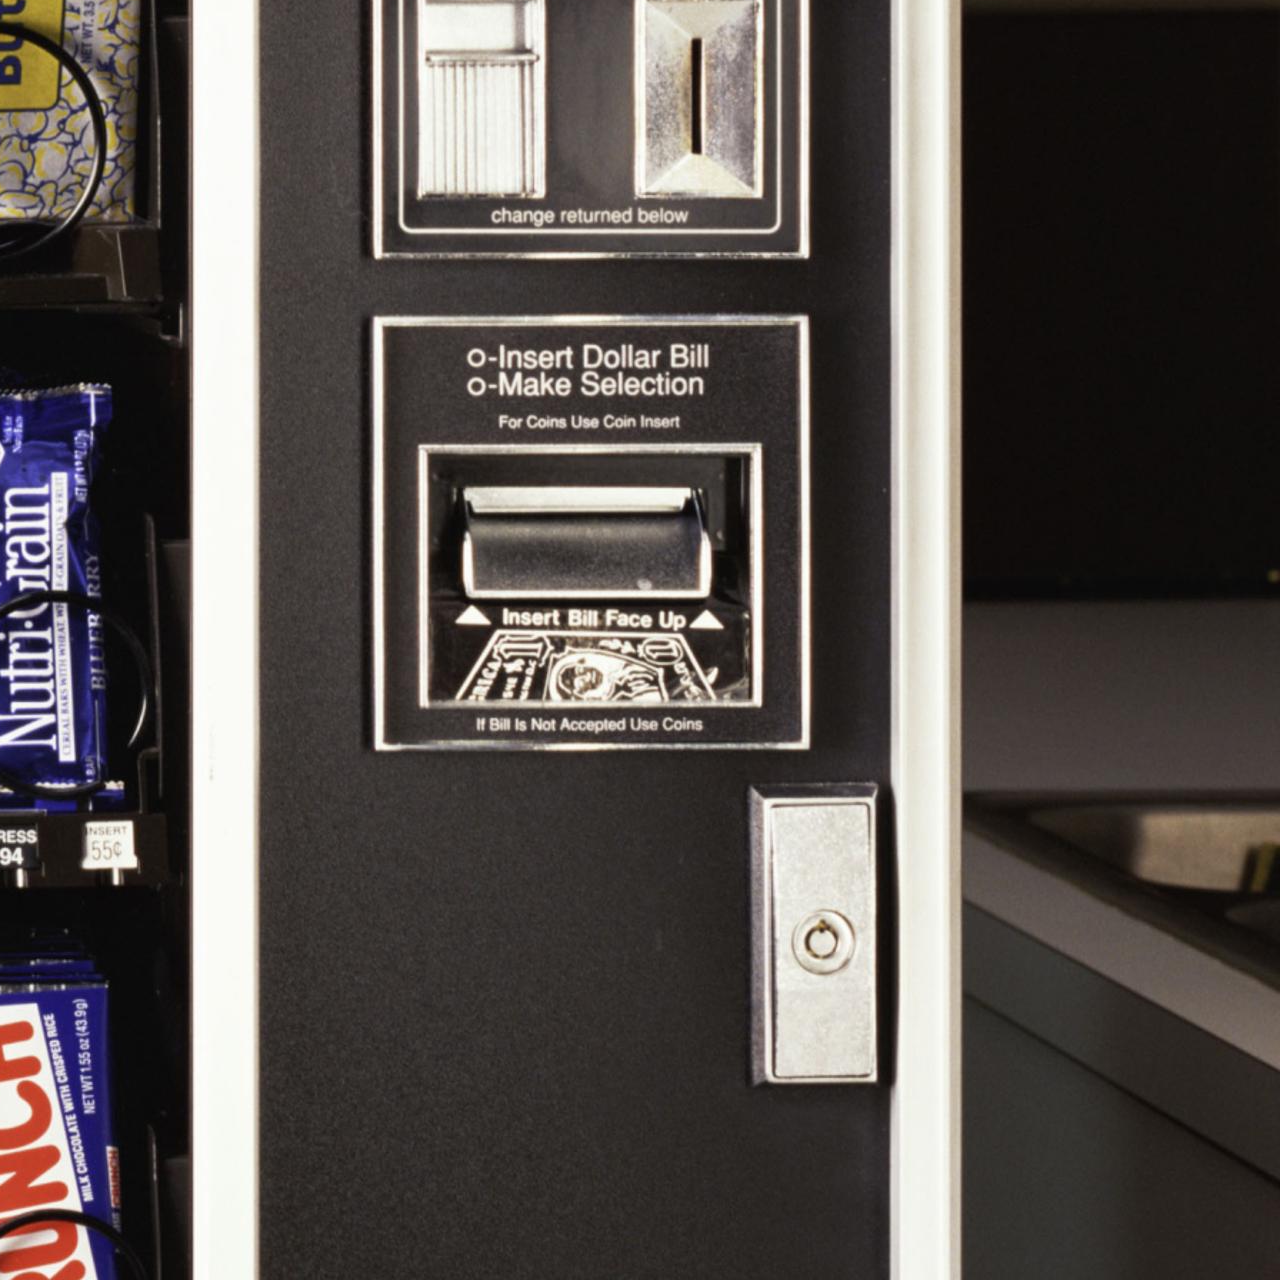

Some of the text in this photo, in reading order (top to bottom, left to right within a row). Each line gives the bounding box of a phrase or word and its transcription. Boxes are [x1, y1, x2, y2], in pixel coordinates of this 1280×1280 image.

[491, 208, 688, 226] change returned below
[583, 345, 661, 369] Dollar
[670, 345, 709, 368] Bill
[580, 372, 703, 396] Selection
[499, 415, 679, 429] For Coins Use Coin Insert
[502, 609, 686, 631] Insert Bill Face Up
[477, 717, 703, 733] If Bill Is Not Accepted Use Coins
